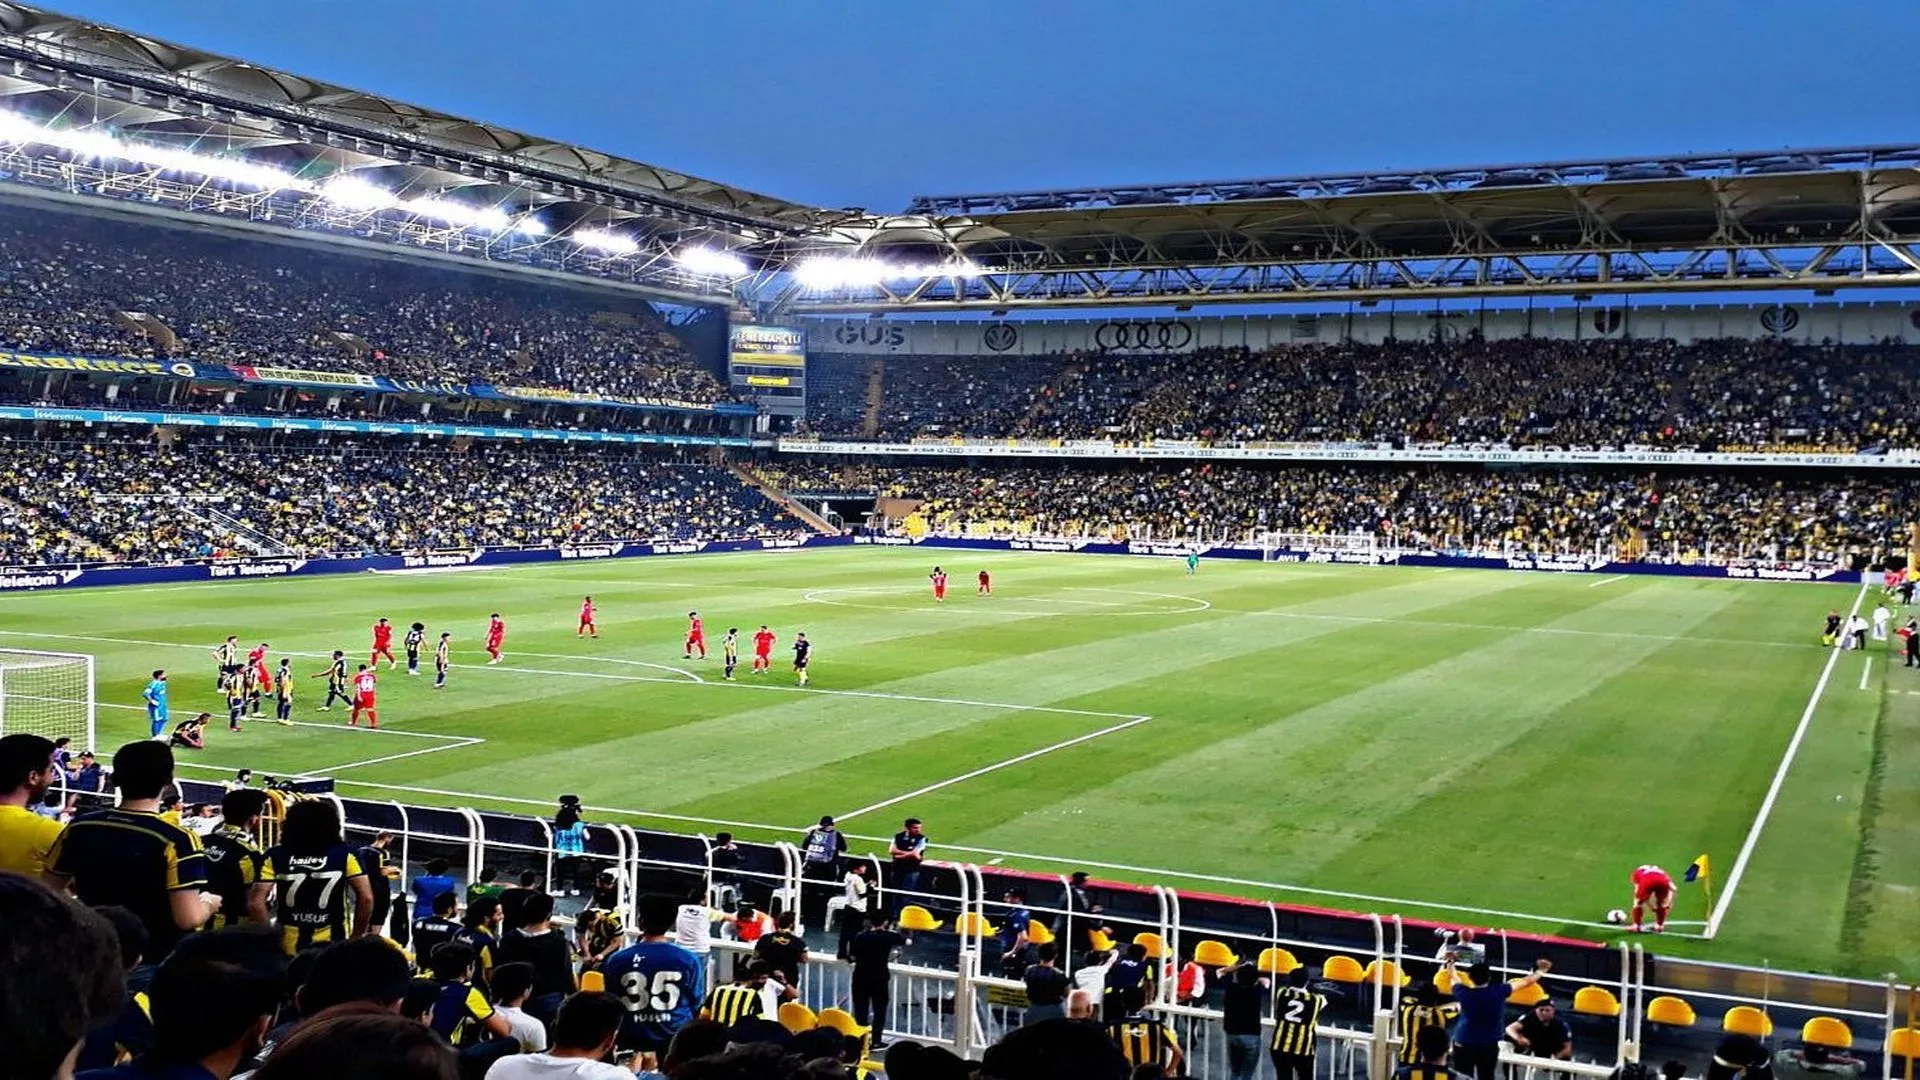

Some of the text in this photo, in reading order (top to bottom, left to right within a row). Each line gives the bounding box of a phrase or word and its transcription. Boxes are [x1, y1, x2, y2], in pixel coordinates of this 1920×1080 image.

[276, 870, 343, 910] 77
[292, 912, 329, 923] YUSUF
[620, 971, 682, 1012] 35
[1285, 1000, 1304, 1023] 2
